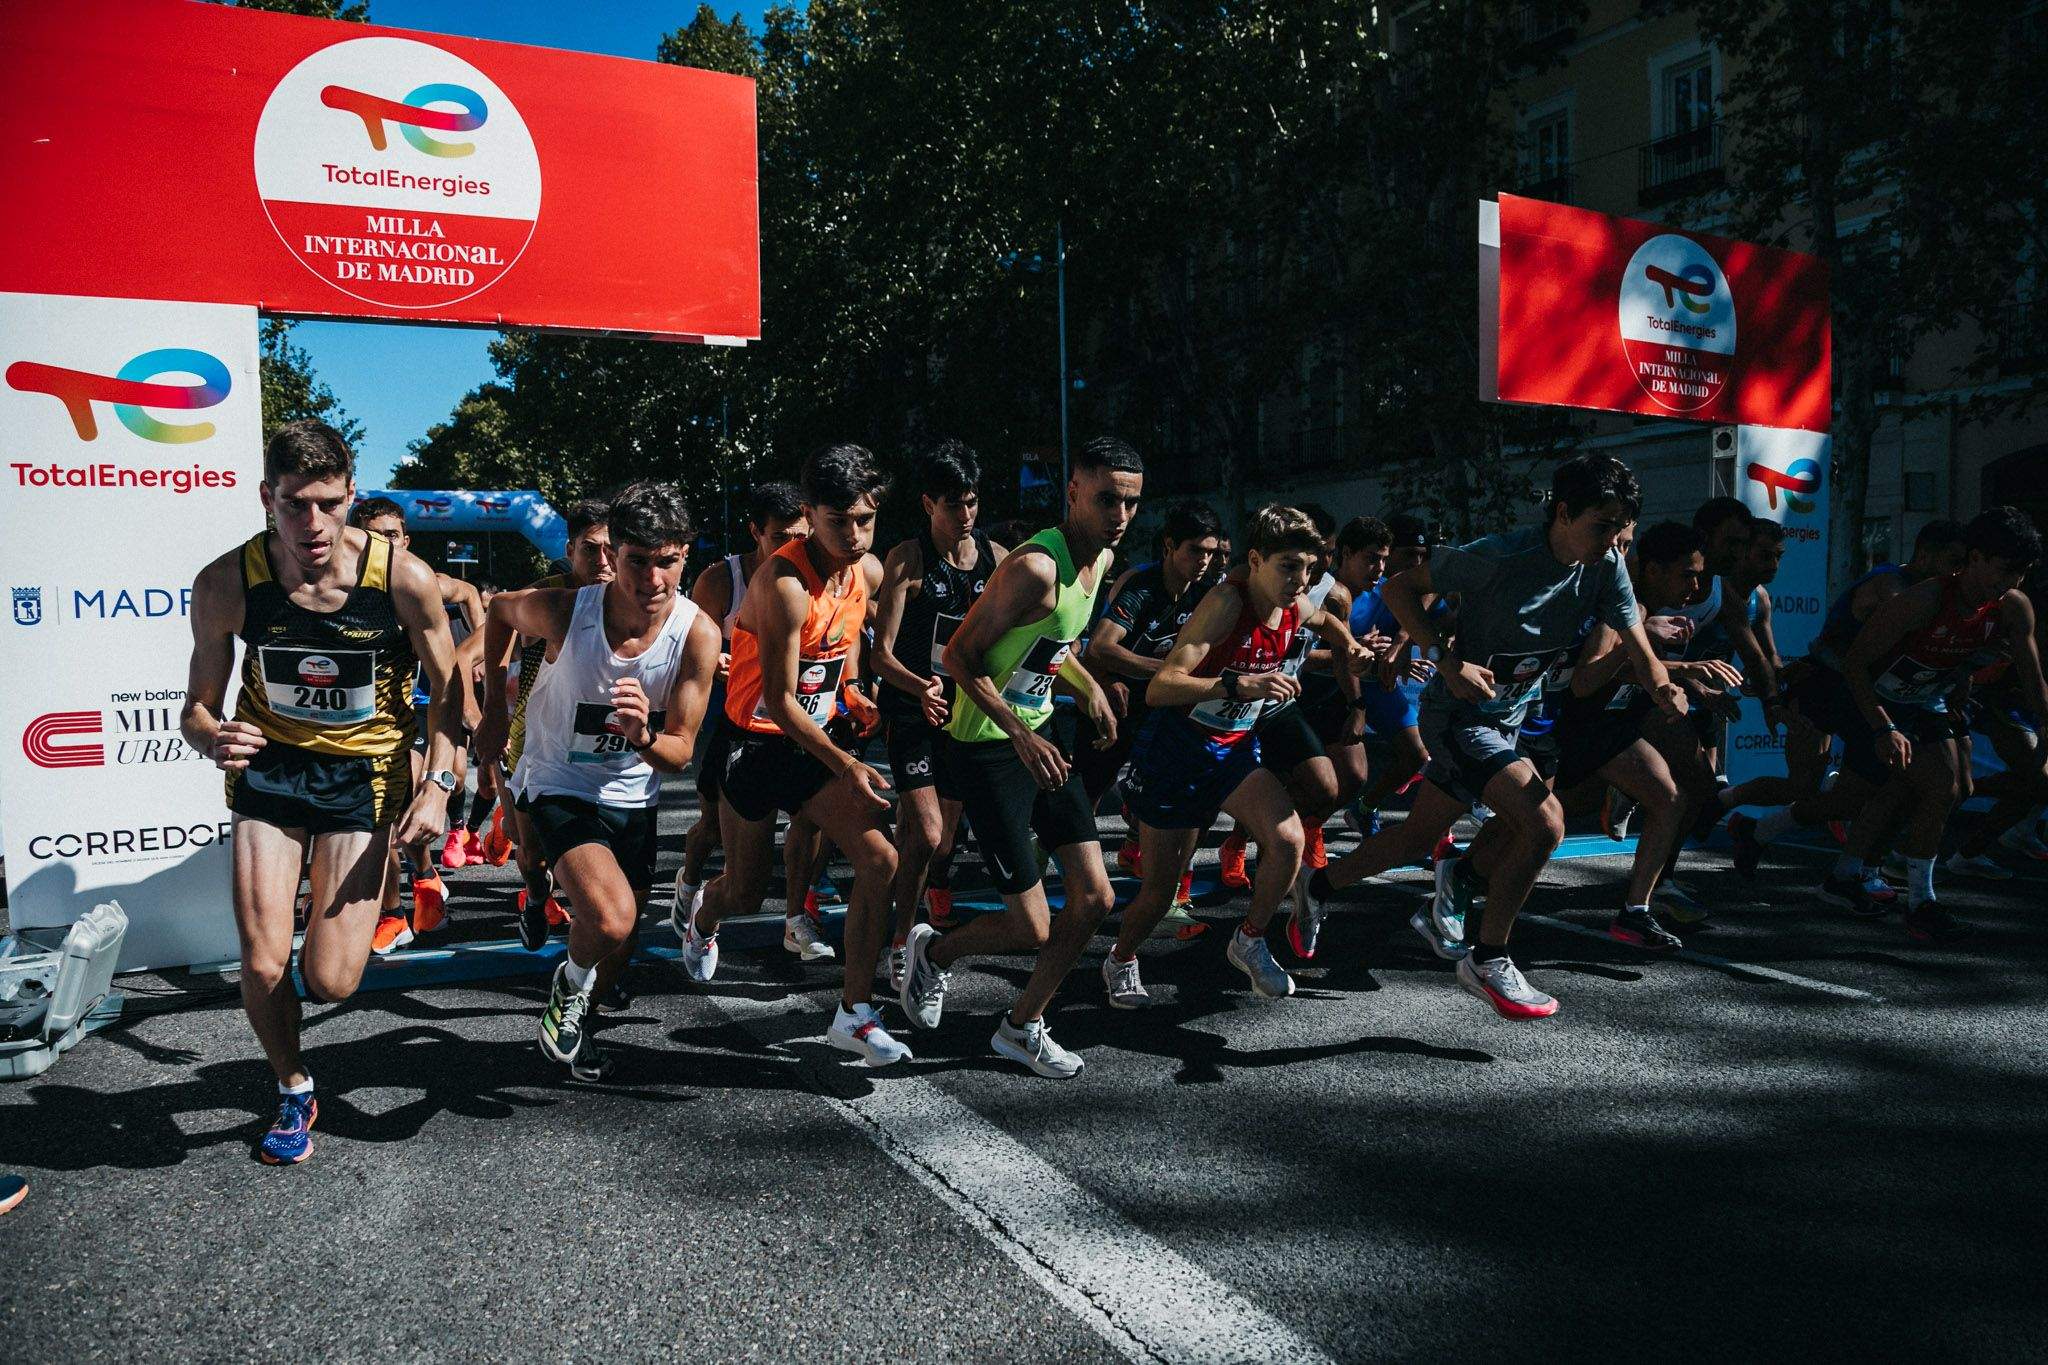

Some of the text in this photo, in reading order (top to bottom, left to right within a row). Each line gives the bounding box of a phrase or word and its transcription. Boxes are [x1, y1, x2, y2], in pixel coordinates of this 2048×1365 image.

[322, 164, 490, 197] TotalEnergies
[366, 215, 445, 238] MILLA
[337, 261, 475, 287] DE MADRID
[1647, 316, 1716, 339] TotalEnergies
[1665, 350, 1697, 365] MILLA
[1652, 380, 1709, 398] DE MADRID
[10, 463, 237, 494] TotalEnergies
[74, 588, 192, 619] MAD
[1771, 596, 1820, 615] ADRID
[111, 688, 187, 703] new balan
[1025, 675, 1053, 697] 23
[293, 686, 348, 711] 240
[111, 708, 181, 734] MIL
